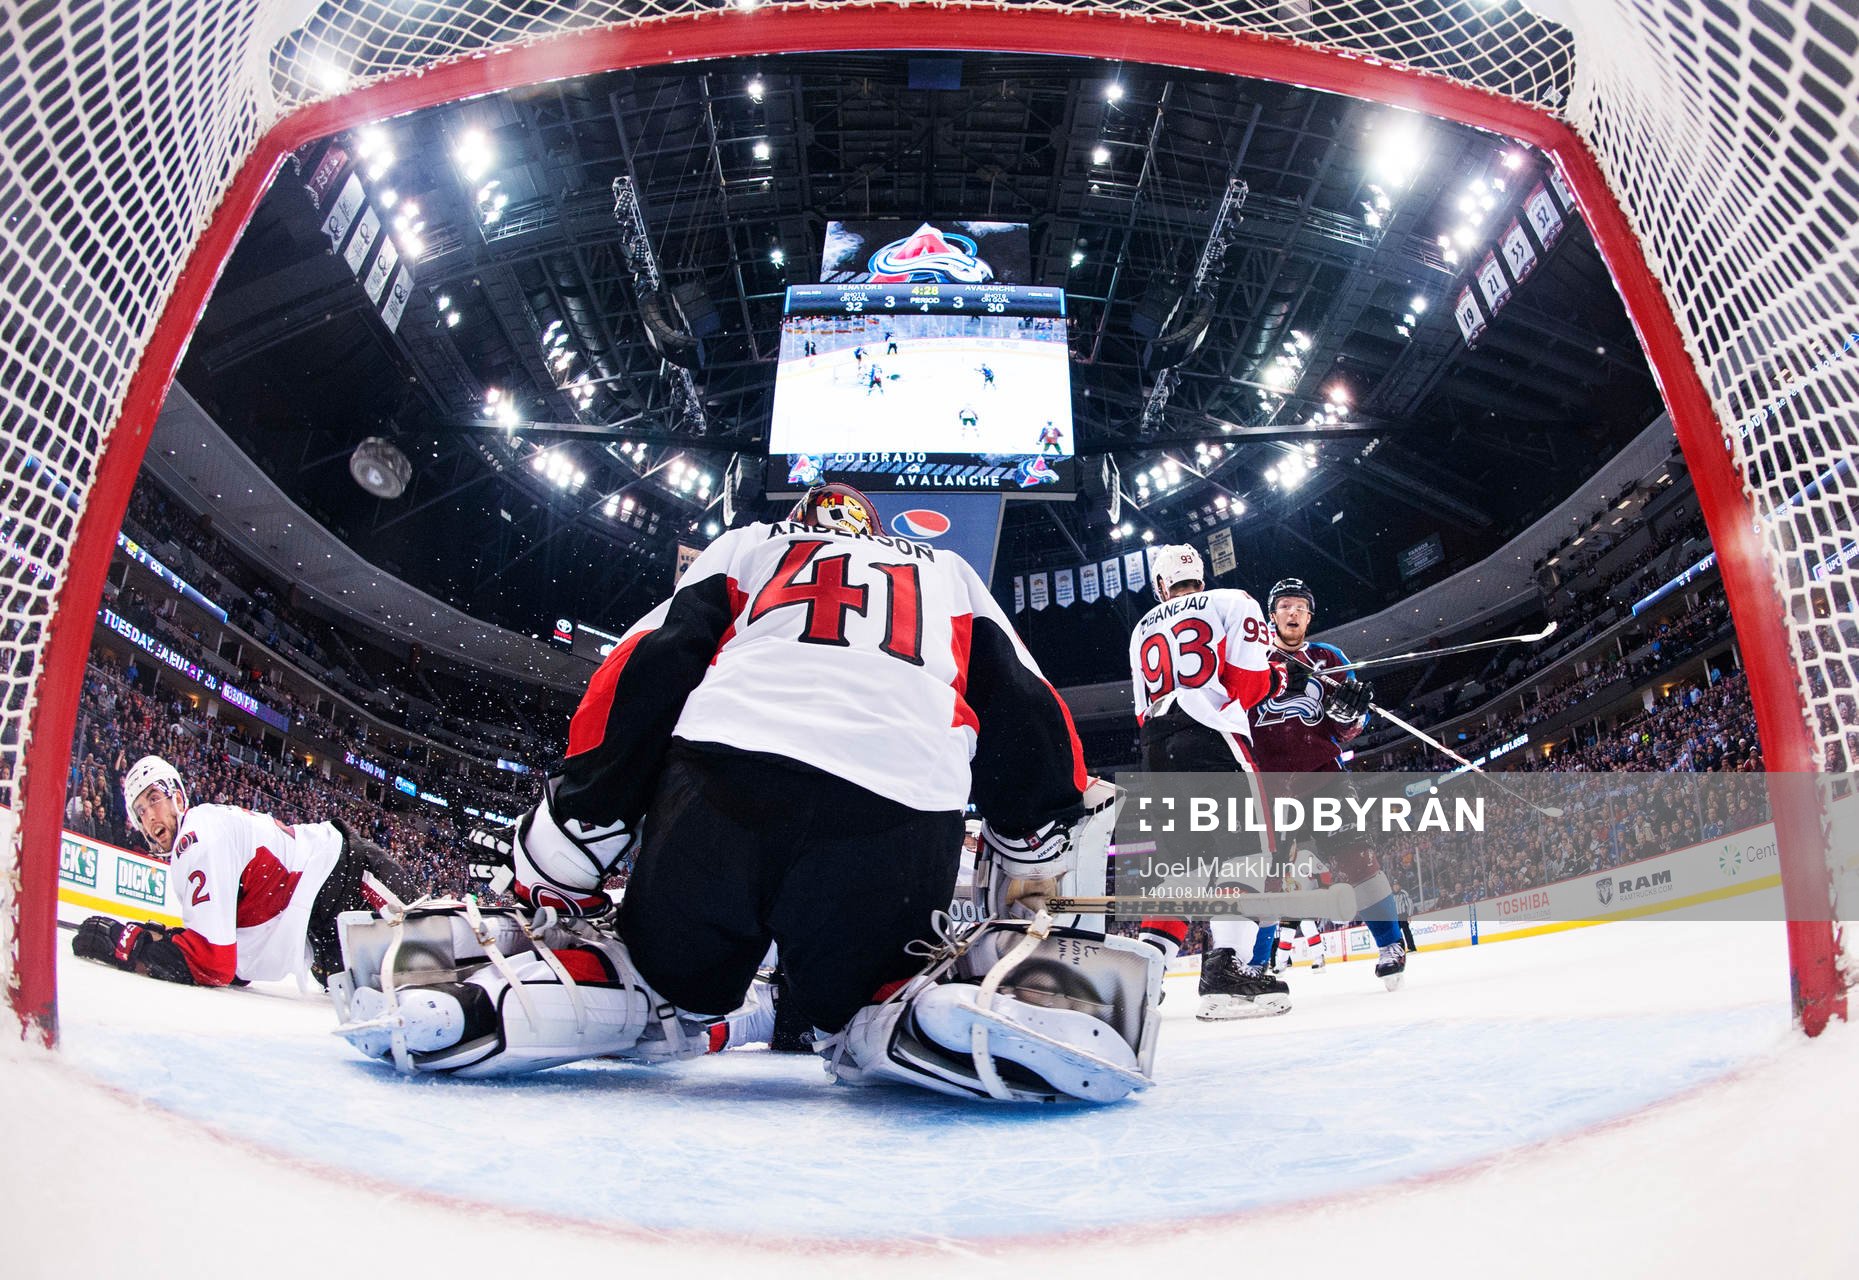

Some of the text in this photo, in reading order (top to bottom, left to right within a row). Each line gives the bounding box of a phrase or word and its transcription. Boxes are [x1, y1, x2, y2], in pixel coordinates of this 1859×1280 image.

[911, 286, 939, 296] 4:28
[1487, 274, 1500, 296] 21
[845, 302, 863, 312] 32
[884, 296, 896, 308] 3
[920, 303, 929, 313] 4
[953, 296, 964, 309] 3
[987, 303, 1004, 313] 30
[1463, 307, 1475, 329] 19
[834, 452, 927, 463] COLORADO
[895, 475, 1000, 487] AVALANCHE
[821, 498, 836, 508] 41
[1180, 554, 1193, 564] 93
[1699, 556, 1713, 572] OTT
[747, 540, 925, 667] 41
[1243, 617, 1270, 646] 93
[1140, 617, 1218, 704] 93
[359, 760, 374, 776] 8:00
[374, 766, 386, 780] PM
[1746, 842, 1778, 863] Cent
[118, 861, 165, 898] DICK'S
[188, 869, 211, 907] 2
[1618, 869, 1672, 894] RAM
[1619, 884, 1673, 902] RAMTRUCKS.COM
[1496, 891, 1550, 917] TOSHIBA
